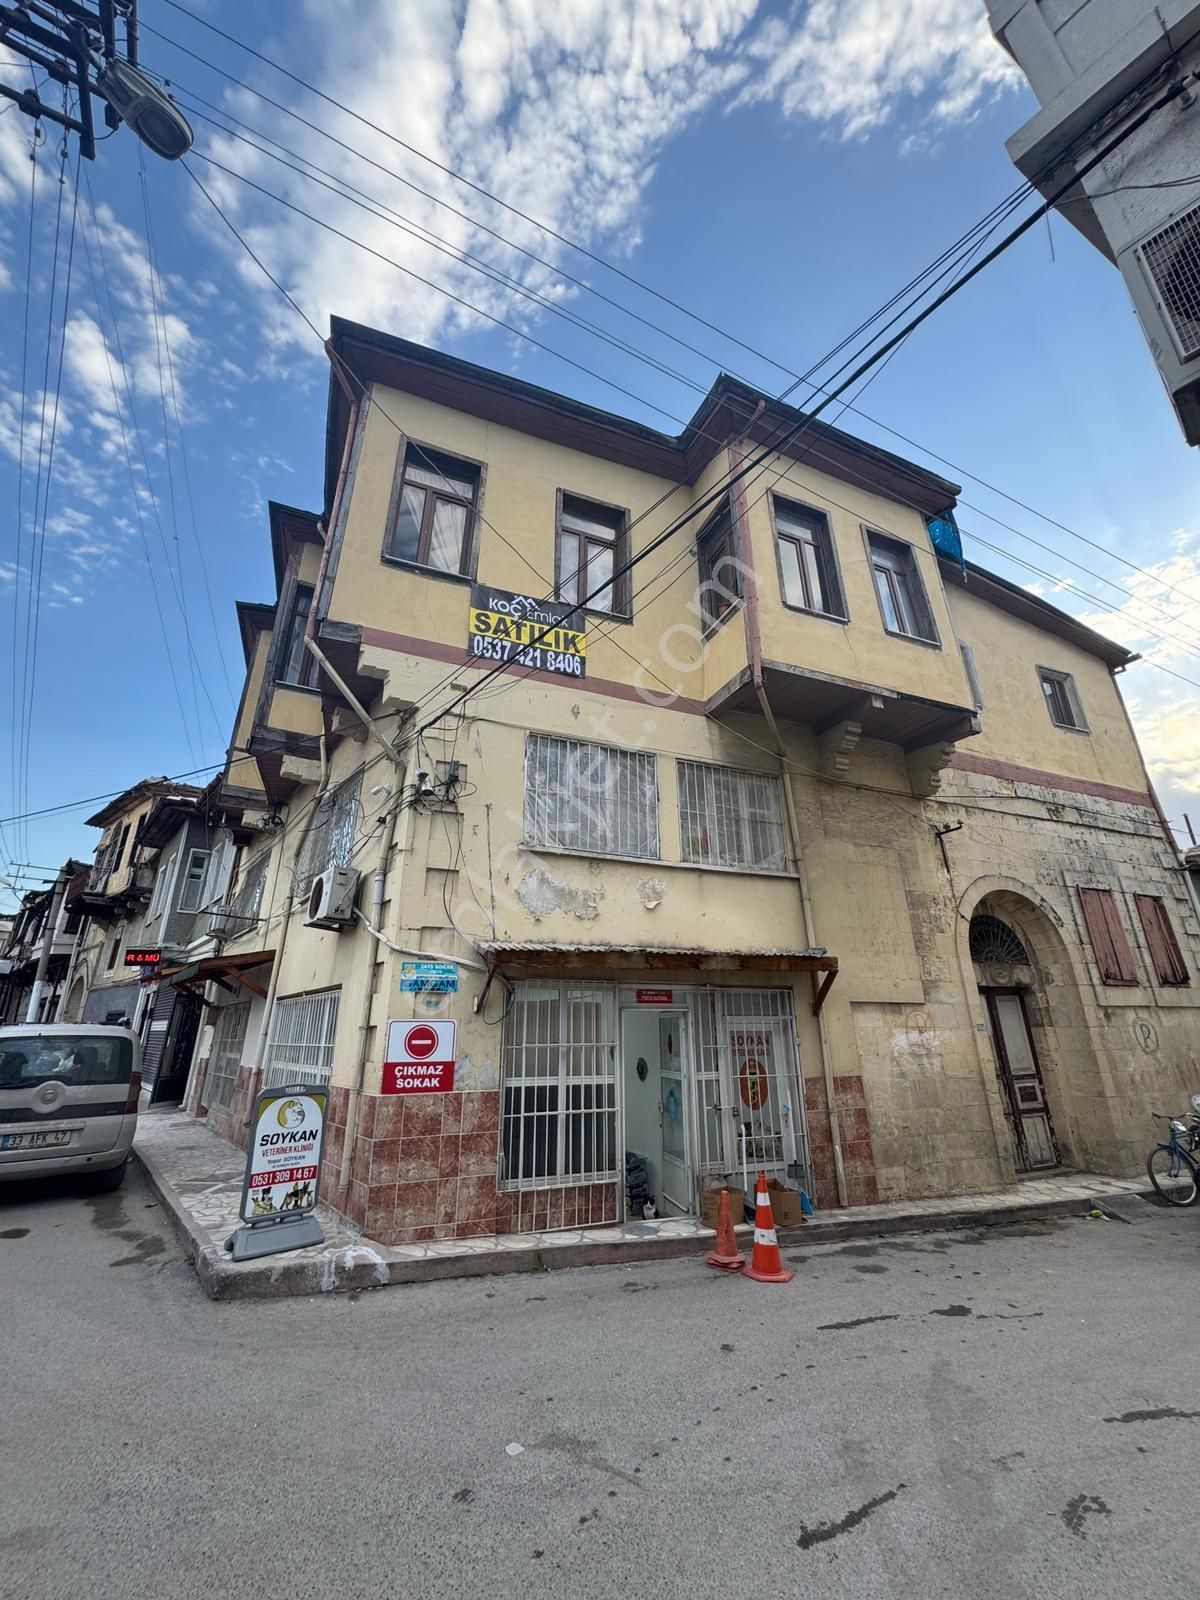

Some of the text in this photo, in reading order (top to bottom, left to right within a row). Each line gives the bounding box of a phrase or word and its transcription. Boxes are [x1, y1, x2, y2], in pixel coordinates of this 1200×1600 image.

[489, 597, 522, 621] KOÇ
[474, 612, 581, 653] SATILIK
[473, 635, 511, 661] 0537
[547, 651, 581, 675] 8406
[730, 1035, 770, 1046] SOYKAN
[394, 1065, 444, 1077] ÇIKMAZ
[396, 1077, 440, 1088] SOKAK
[9, 1136, 23, 1146] 33
[28, 1133, 49, 1145] AFK
[260, 1129, 318, 1146] SOYKAN
[262, 1146, 293, 1157] VETERİNER
[252, 1167, 314, 1186] 0531 309 14 67
